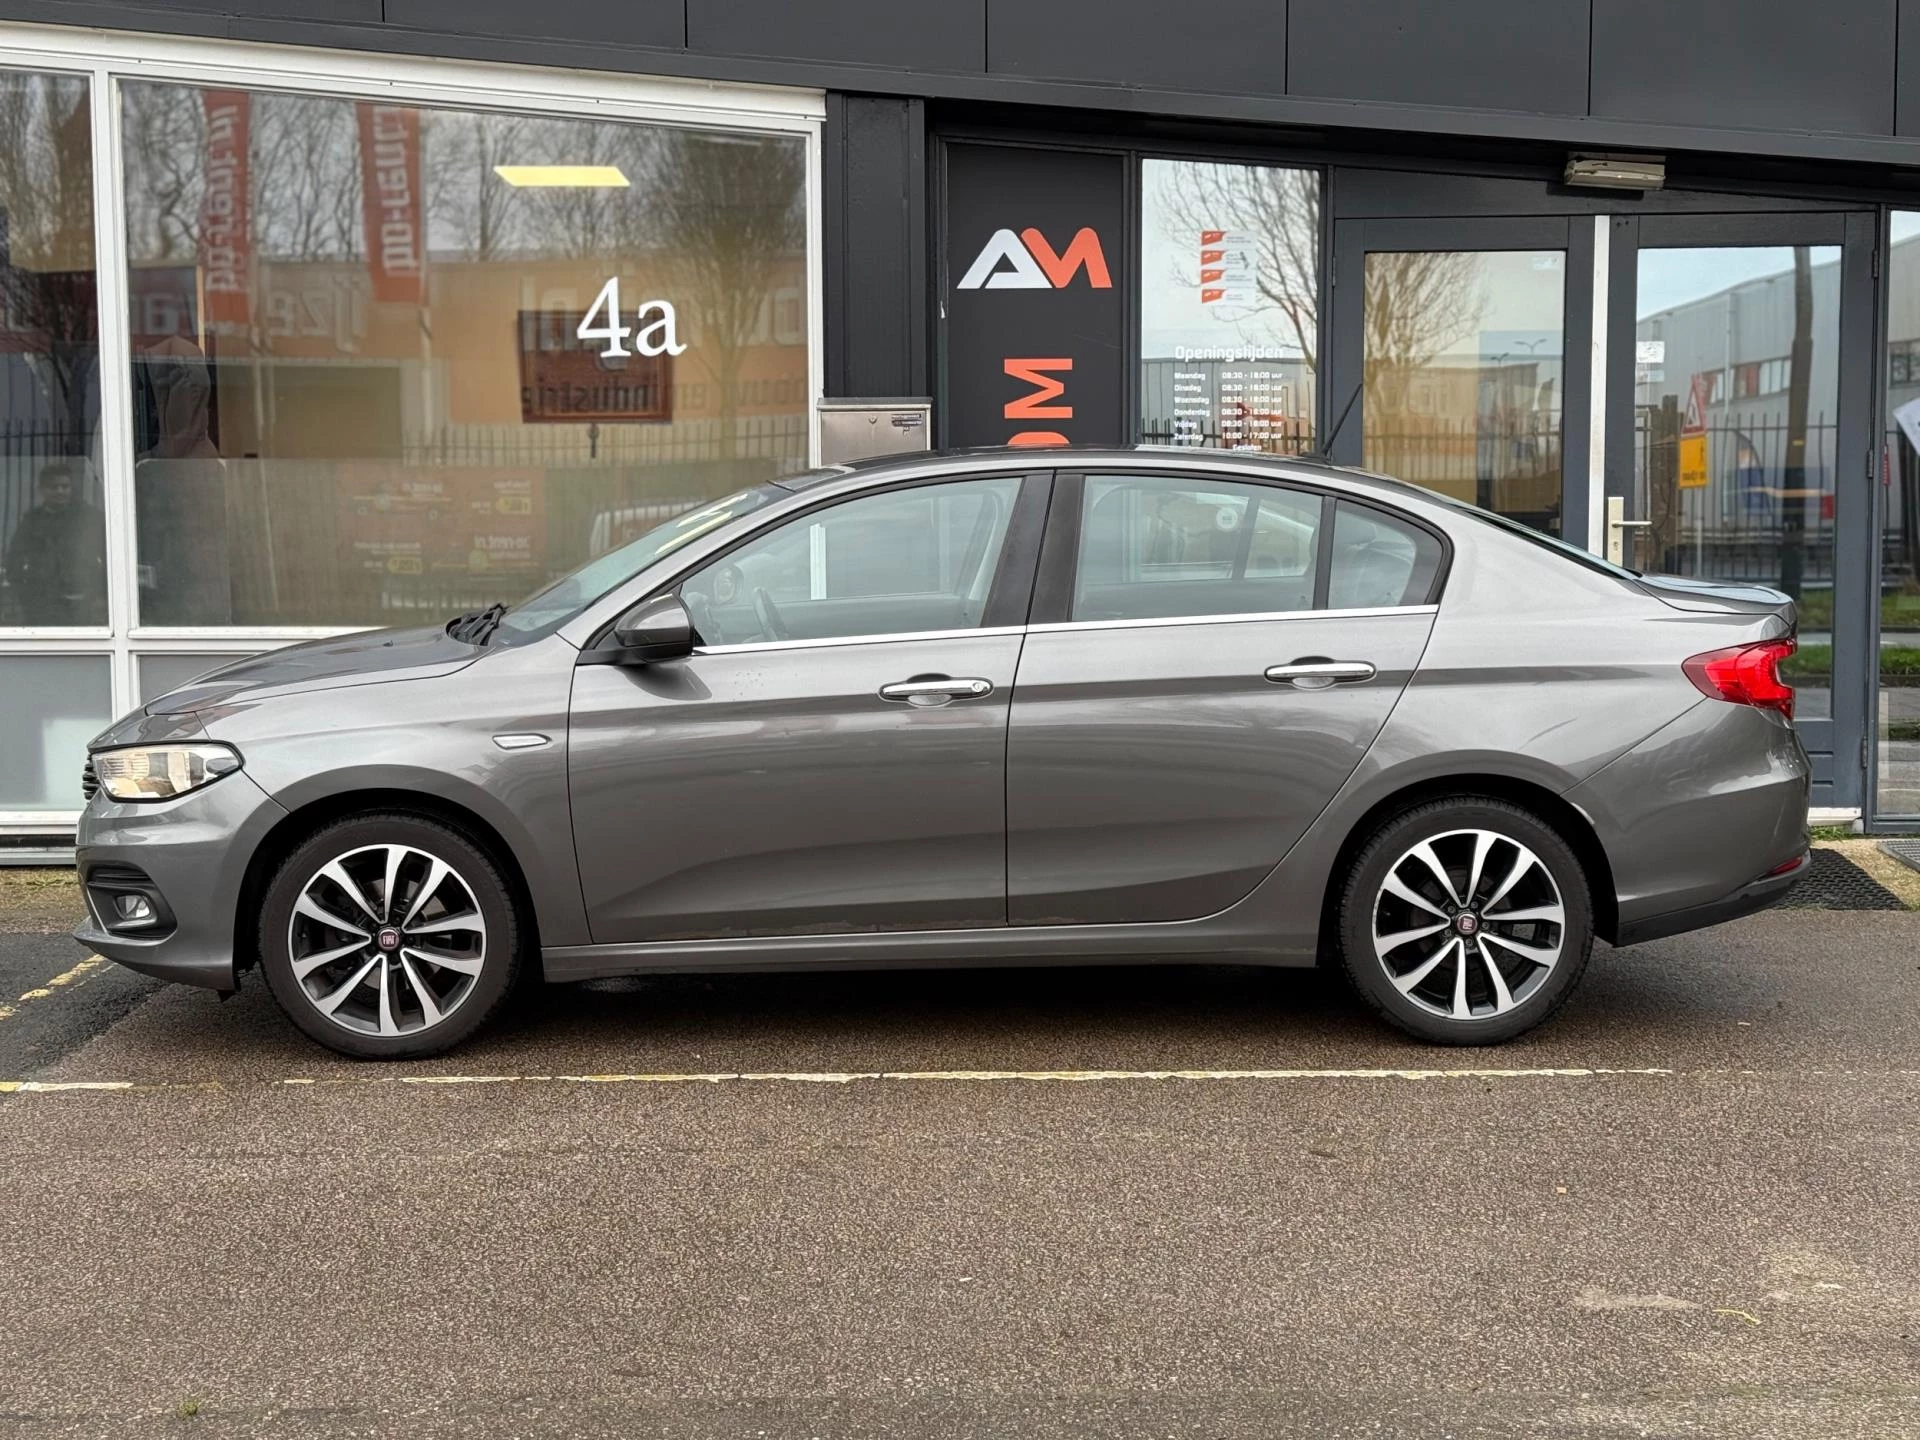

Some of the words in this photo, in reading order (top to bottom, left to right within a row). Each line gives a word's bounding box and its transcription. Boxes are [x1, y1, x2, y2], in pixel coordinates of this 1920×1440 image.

[957, 227, 1112, 289] AM
[577, 276, 688, 358] 4a
[1175, 345, 1283, 362] Openingstijden
[1174, 372, 1206, 380] Maandag
[1174, 384, 1202, 392] Dinsdag
[1174, 408, 1211, 417] Donderdag
[1174, 420, 1198, 429] Vrijdag
[1174, 433, 1204, 441] Zaterdag
[383, 935, 395, 945] FIAT
